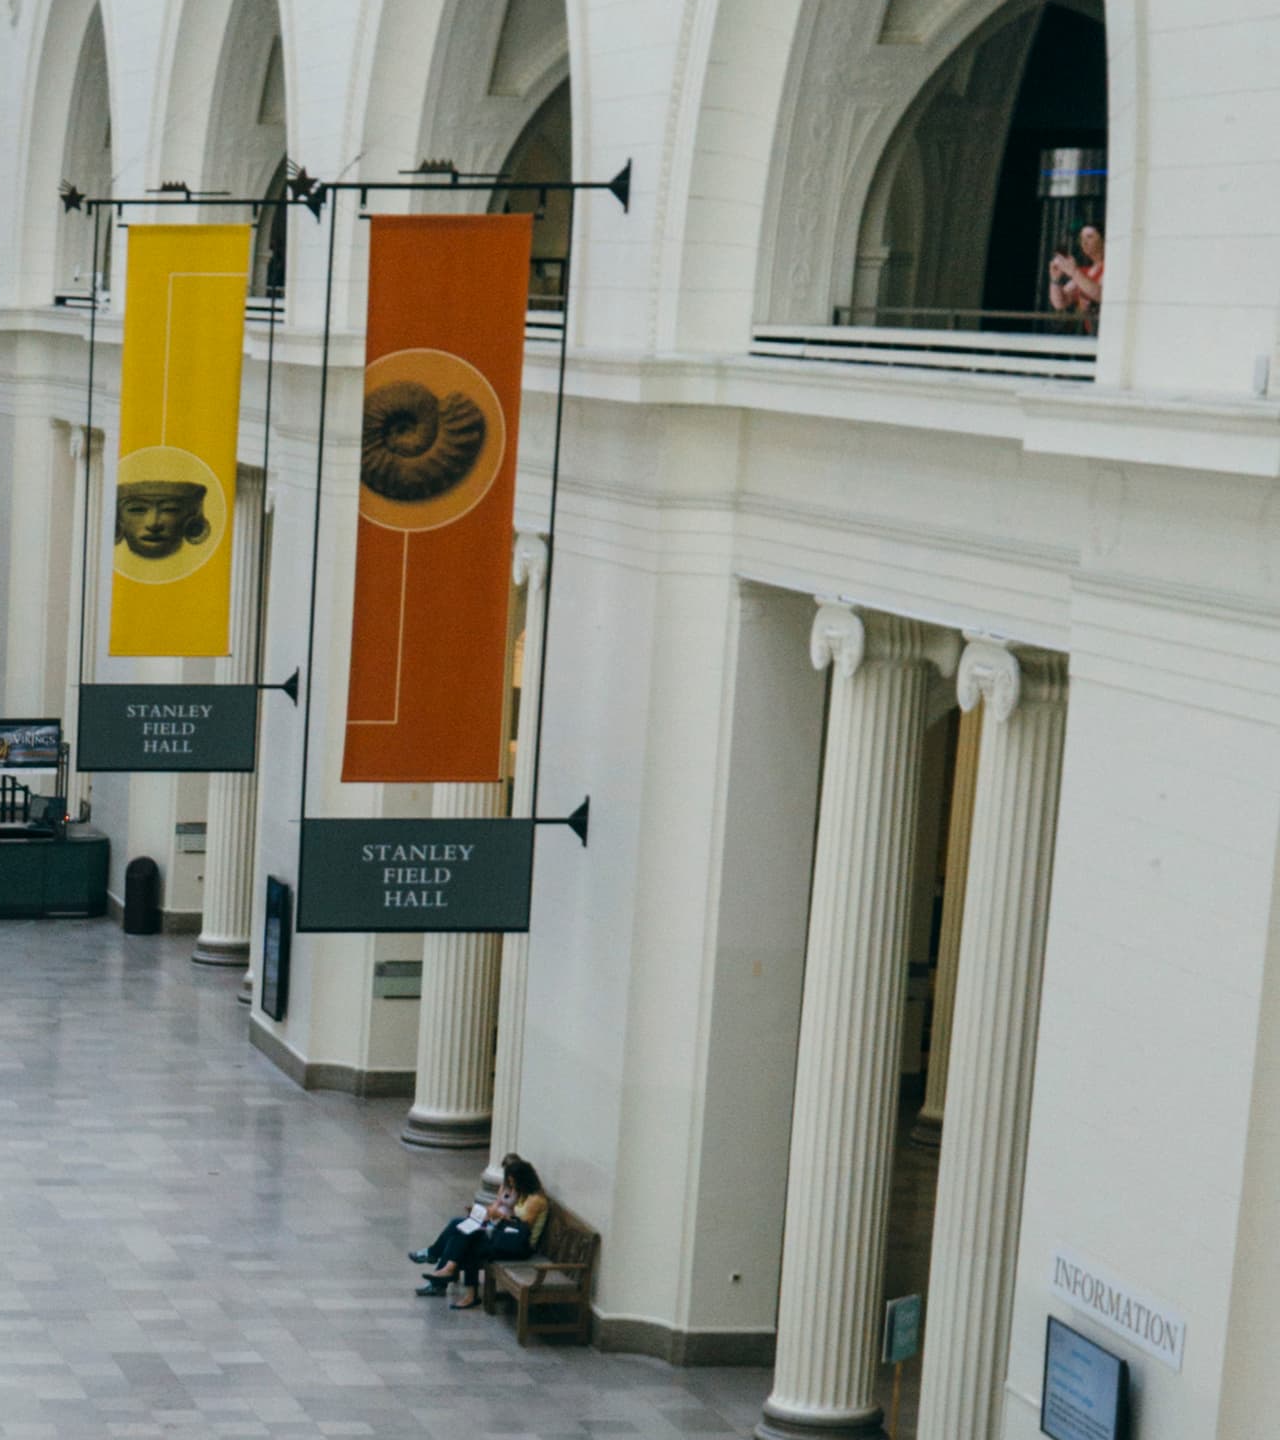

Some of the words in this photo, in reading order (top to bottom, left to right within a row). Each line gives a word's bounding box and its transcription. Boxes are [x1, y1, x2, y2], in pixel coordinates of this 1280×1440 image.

[126, 703, 213, 718] STANLEY
[143, 722, 195, 735] FIELD
[143, 739, 193, 753] HALL
[361, 844, 475, 862] STANLEY
[383, 867, 452, 884] FIELD
[384, 890, 449, 907] HALL
[1053, 1256, 1178, 1355] INFORMATION
